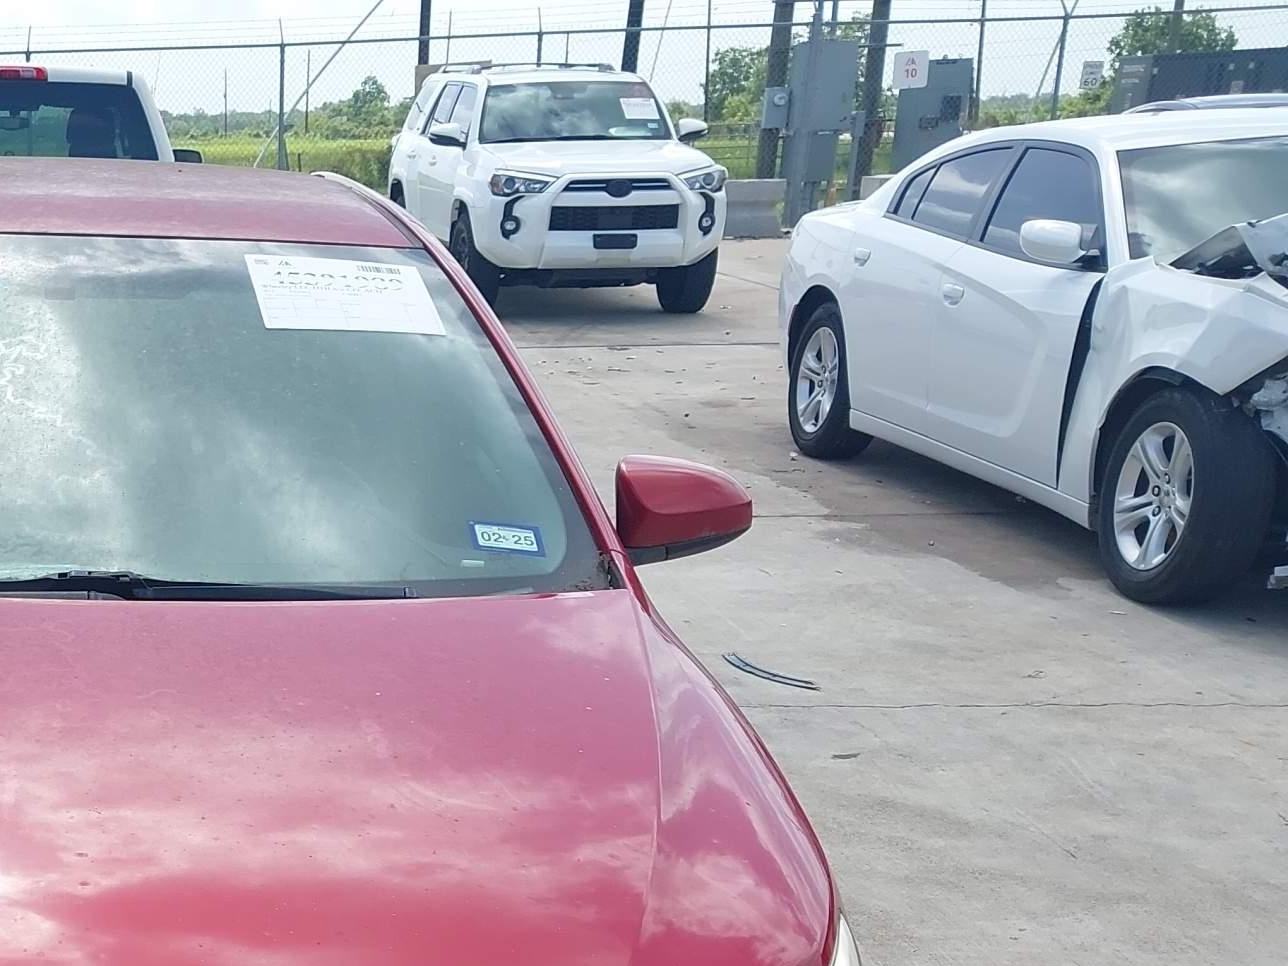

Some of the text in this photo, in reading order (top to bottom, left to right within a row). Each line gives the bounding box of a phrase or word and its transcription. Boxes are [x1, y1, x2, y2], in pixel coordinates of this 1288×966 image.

[904, 68, 917, 78] 10
[481, 531, 534, 546] 02 25
